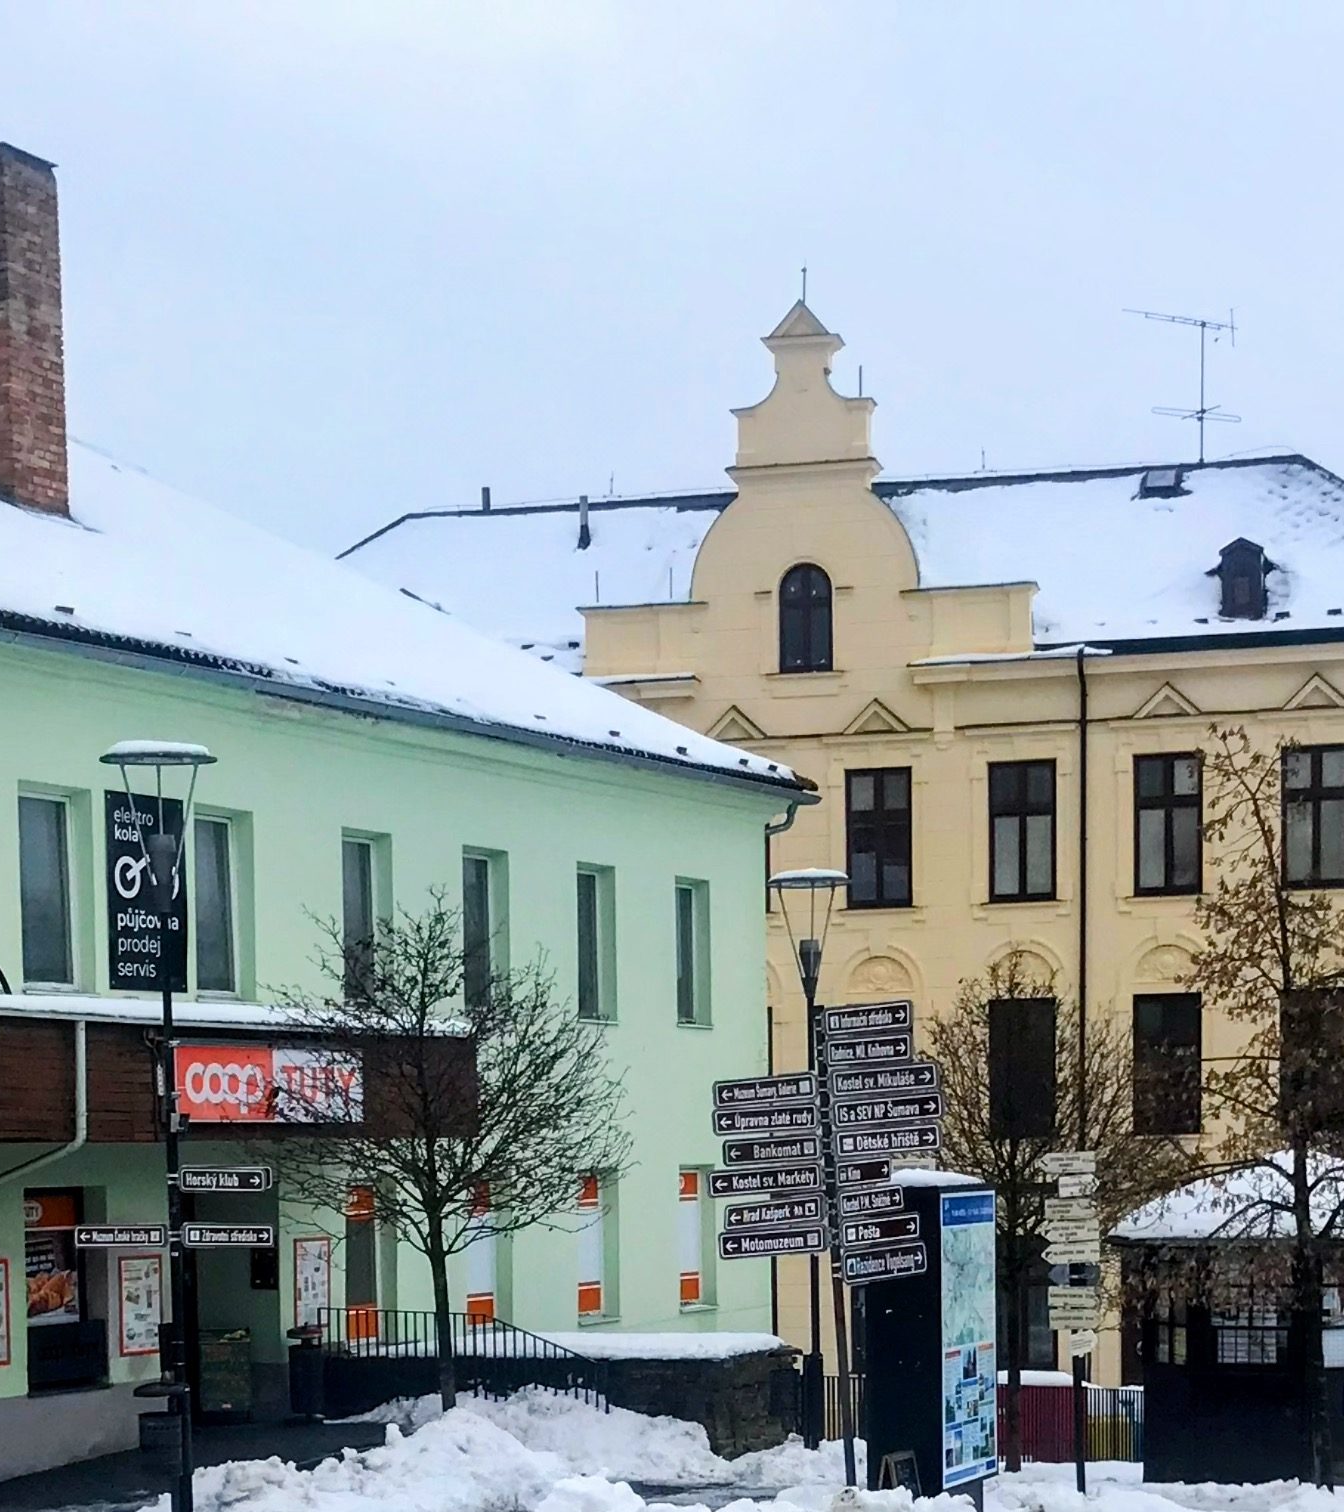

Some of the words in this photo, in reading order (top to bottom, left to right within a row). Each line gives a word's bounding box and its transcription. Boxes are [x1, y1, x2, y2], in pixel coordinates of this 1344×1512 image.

[114, 824, 139, 842] kola
[118, 935, 161, 957] prodej
[118, 959, 157, 978] servis
[185, 1062, 264, 1114] coop
[837, 1074, 863, 1091] Kostel
[864, 1077, 876, 1089] sv.
[877, 1070, 915, 1087] Mikuláše
[839, 1107, 848, 1121] IS
[849, 1110, 855, 1120] a
[856, 1105, 873, 1120] SEV
[874, 1104, 885, 1118] NP
[887, 1100, 919, 1117] Šumava
[734, 1112, 768, 1131] Úpravna
[771, 1111, 790, 1126] zlaté
[793, 1110, 812, 1126] rudy
[856, 1133, 889, 1150] Dětské
[890, 1131, 919, 1147] hřiště
[753, 1142, 801, 1159] Bankomat
[185, 1174, 218, 1190] Horský
[218, 1173, 239, 1187] klub
[732, 1174, 761, 1190] Kostel
[762, 1176, 776, 1187] sv.
[777, 1170, 814, 1187] Markéty
[847, 1166, 861, 1180] Kino
[742, 1208, 760, 1223] Hrad
[761, 1204, 791, 1221] Kašperk
[858, 1225, 880, 1240] Pošta
[741, 1235, 804, 1252] Motomuzeum
[885, 1252, 915, 1275] Vogelsang
